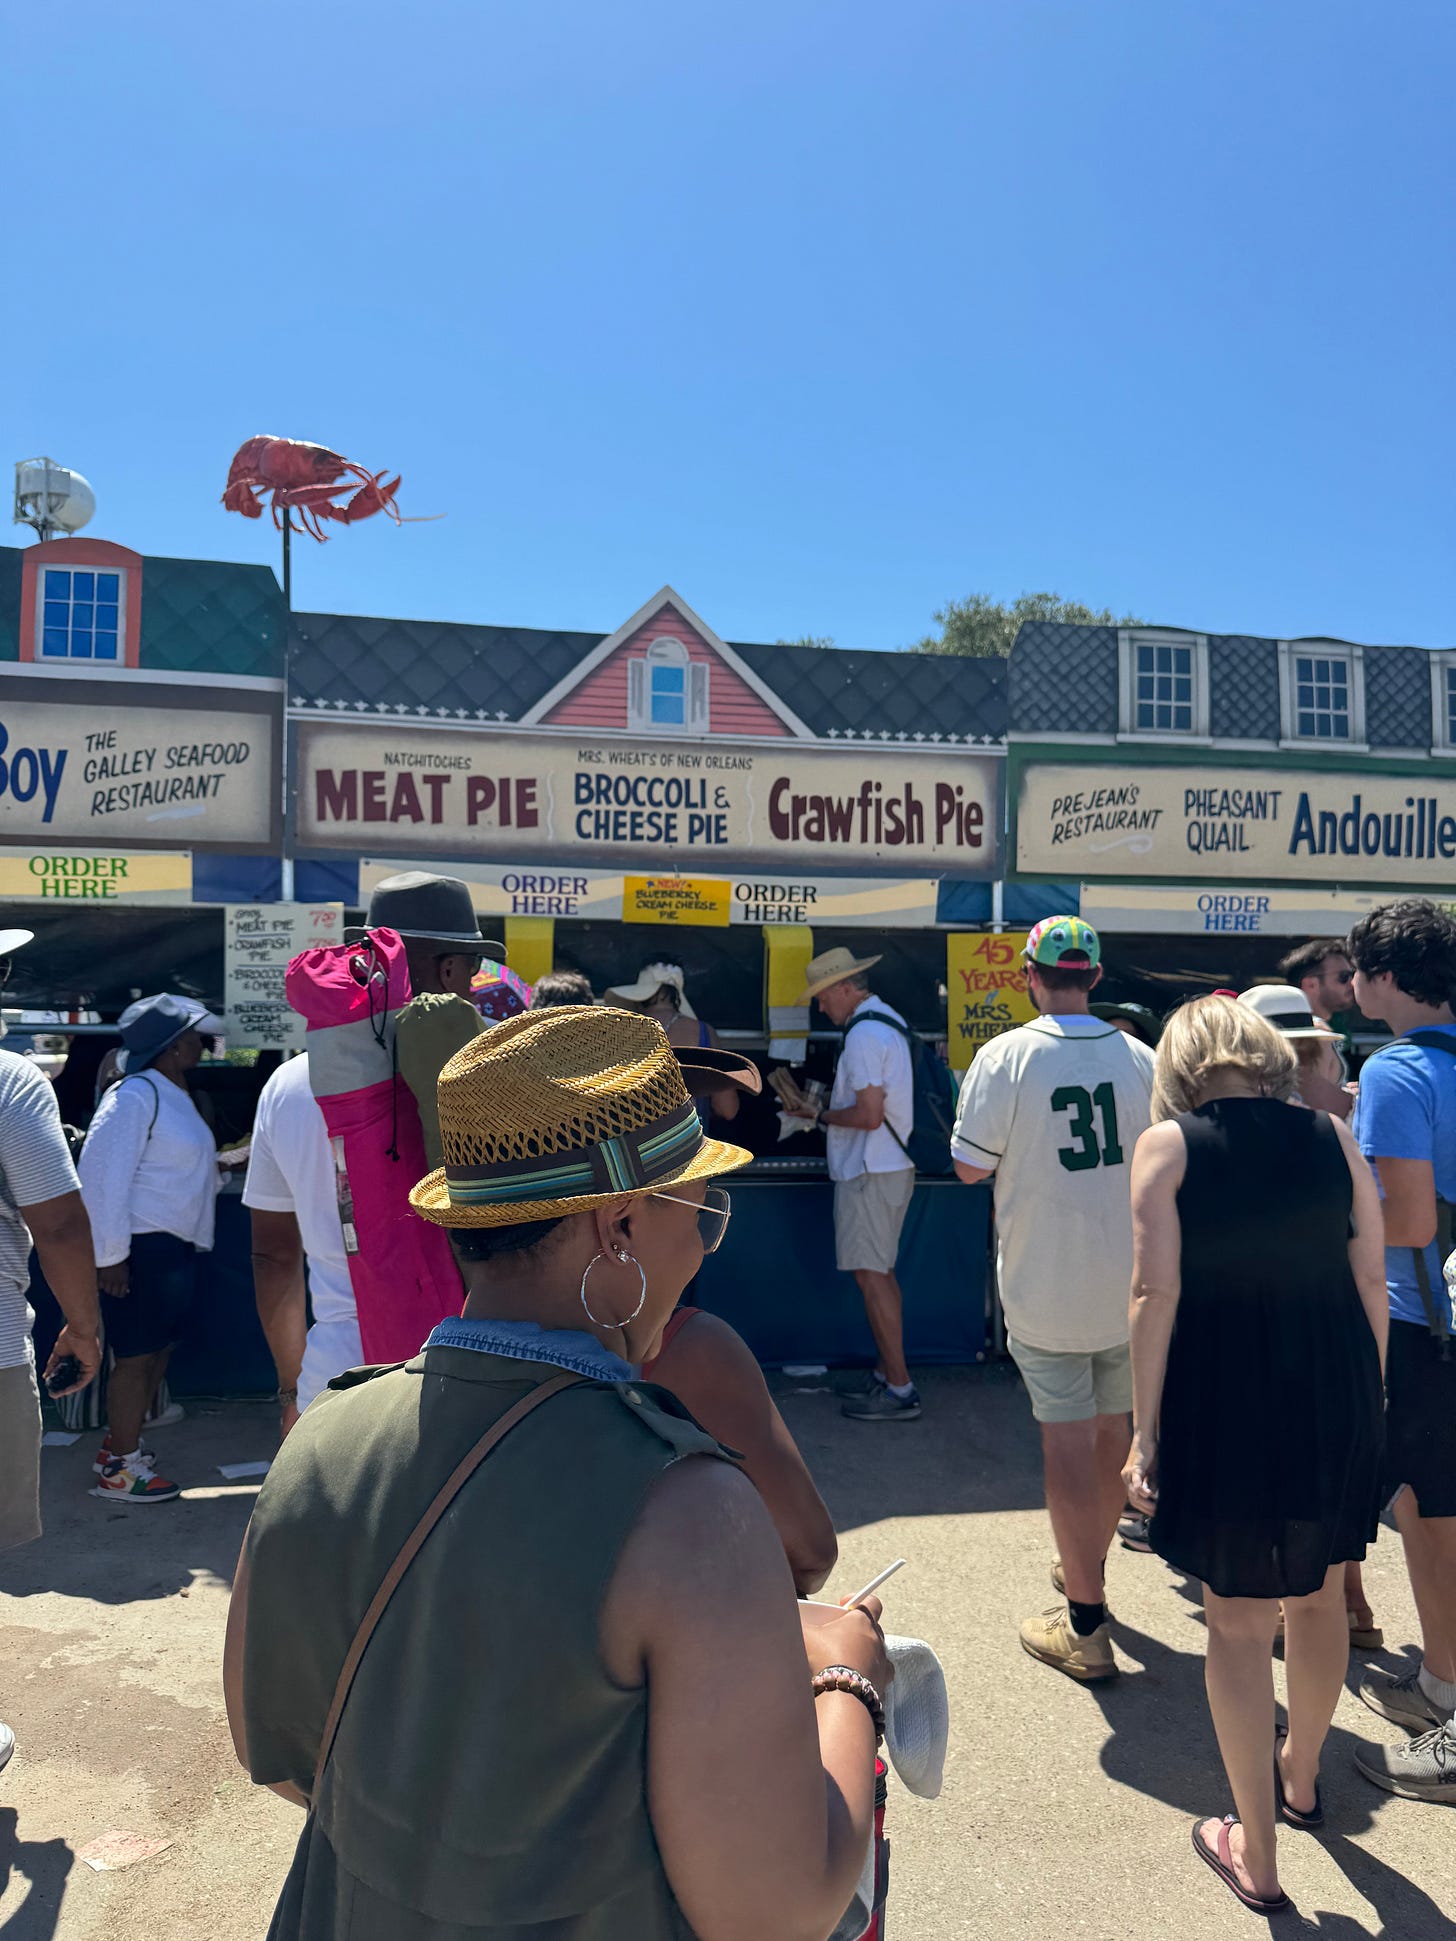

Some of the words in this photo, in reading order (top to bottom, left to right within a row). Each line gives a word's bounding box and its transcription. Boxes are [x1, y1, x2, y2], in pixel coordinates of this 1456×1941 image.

[85, 730, 117, 752] THE
[84, 747, 157, 783] GALLEY
[164, 742, 250, 769] SEAFOOD
[384, 752, 472, 770] NATCHITOCHES
[577, 750, 605, 764] MRS.
[608, 752, 657, 766] WHEAT'S
[660, 754, 674, 767] OF
[677, 754, 703, 768] NEW
[705, 756, 753, 770] ORLEANS
[0, 720, 68, 823] oy
[90, 773, 225, 816] RESTAURANT
[316, 768, 451, 824] MEAT
[467, 776, 539, 828] PIE
[575, 773, 706, 808] BROCCOLI
[1051, 783, 1140, 820] PREJEAN'S
[768, 776, 924, 845] Crawfish
[935, 782, 983, 847] Pie
[1184, 789, 1282, 820] PHEASANT
[576, 809, 678, 842] CHEESE
[688, 814, 728, 844] PIE
[1051, 809, 1163, 845] RESTAURANT
[1288, 792, 1456, 859] Andouille
[29, 855, 128, 877] ORDER
[41, 879, 118, 899] HERE
[502, 873, 588, 896] ORDER
[636, 889, 701, 900] BLUEBERRY
[735, 883, 817, 904] ORDER
[511, 896, 579, 915] HERE
[636, 900, 672, 910] CREAM
[675, 901, 718, 911] CHEESE
[744, 904, 807, 923] HERE
[1197, 894, 1269, 913] ORDER
[236, 919, 268, 932] MEAT
[272, 919, 295, 931] PIE
[659, 910, 679, 920] PIE
[1204, 913, 1260, 931] HERE
[235, 938, 291, 950] CRAWFISH
[971, 936, 1014, 965] 45
[958, 967, 1028, 994] YEARS
[964, 1001, 1012, 1020] MRS
[244, 1023, 294, 1033] CHEESE
[1051, 1082, 1123, 1171] 31
